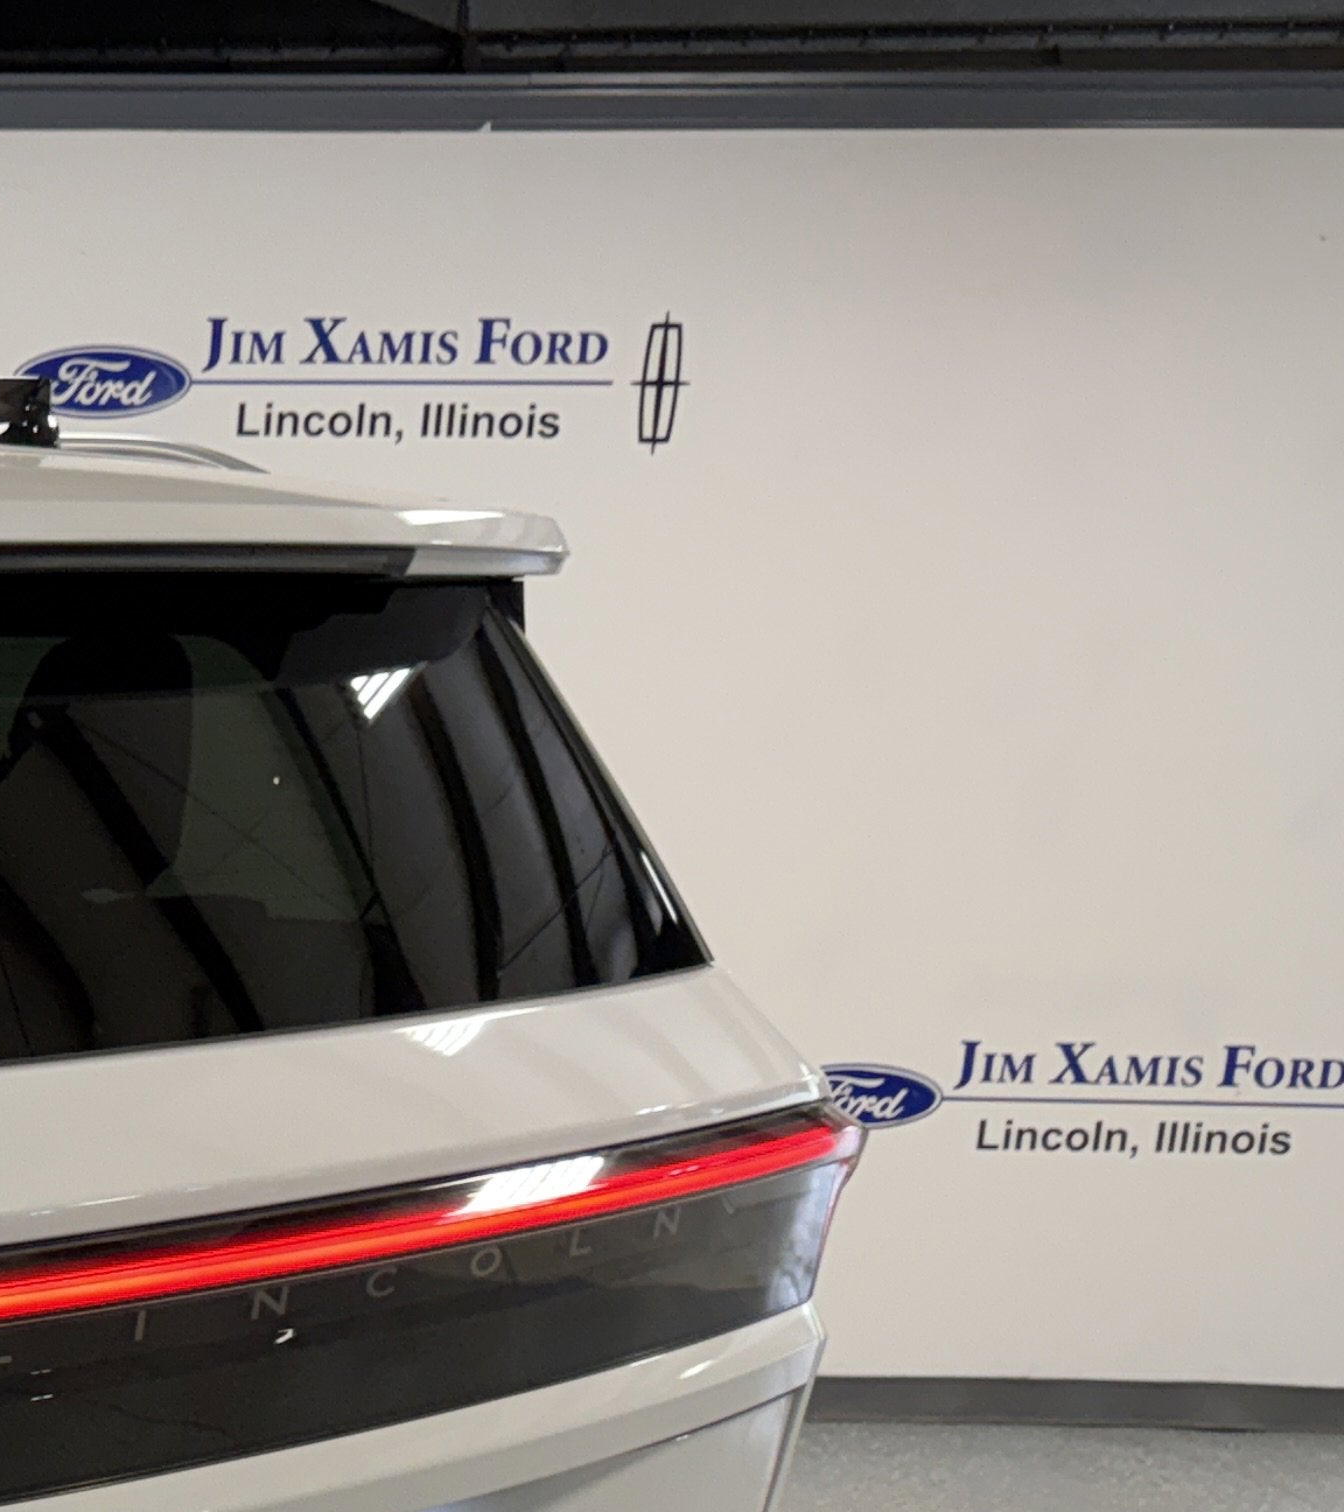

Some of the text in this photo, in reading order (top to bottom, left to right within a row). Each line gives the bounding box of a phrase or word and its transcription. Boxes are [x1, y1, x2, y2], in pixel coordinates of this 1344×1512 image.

[201, 317, 610, 374] JIM XAMIS FORD
[50, 356, 154, 408] Ford
[235, 402, 561, 445] Lincoln, Illinois
[953, 1039, 1037, 1091] JIM
[1048, 1041, 1204, 1088] XAMIS
[975, 1119, 1292, 1158] Lincoln, Illinois
